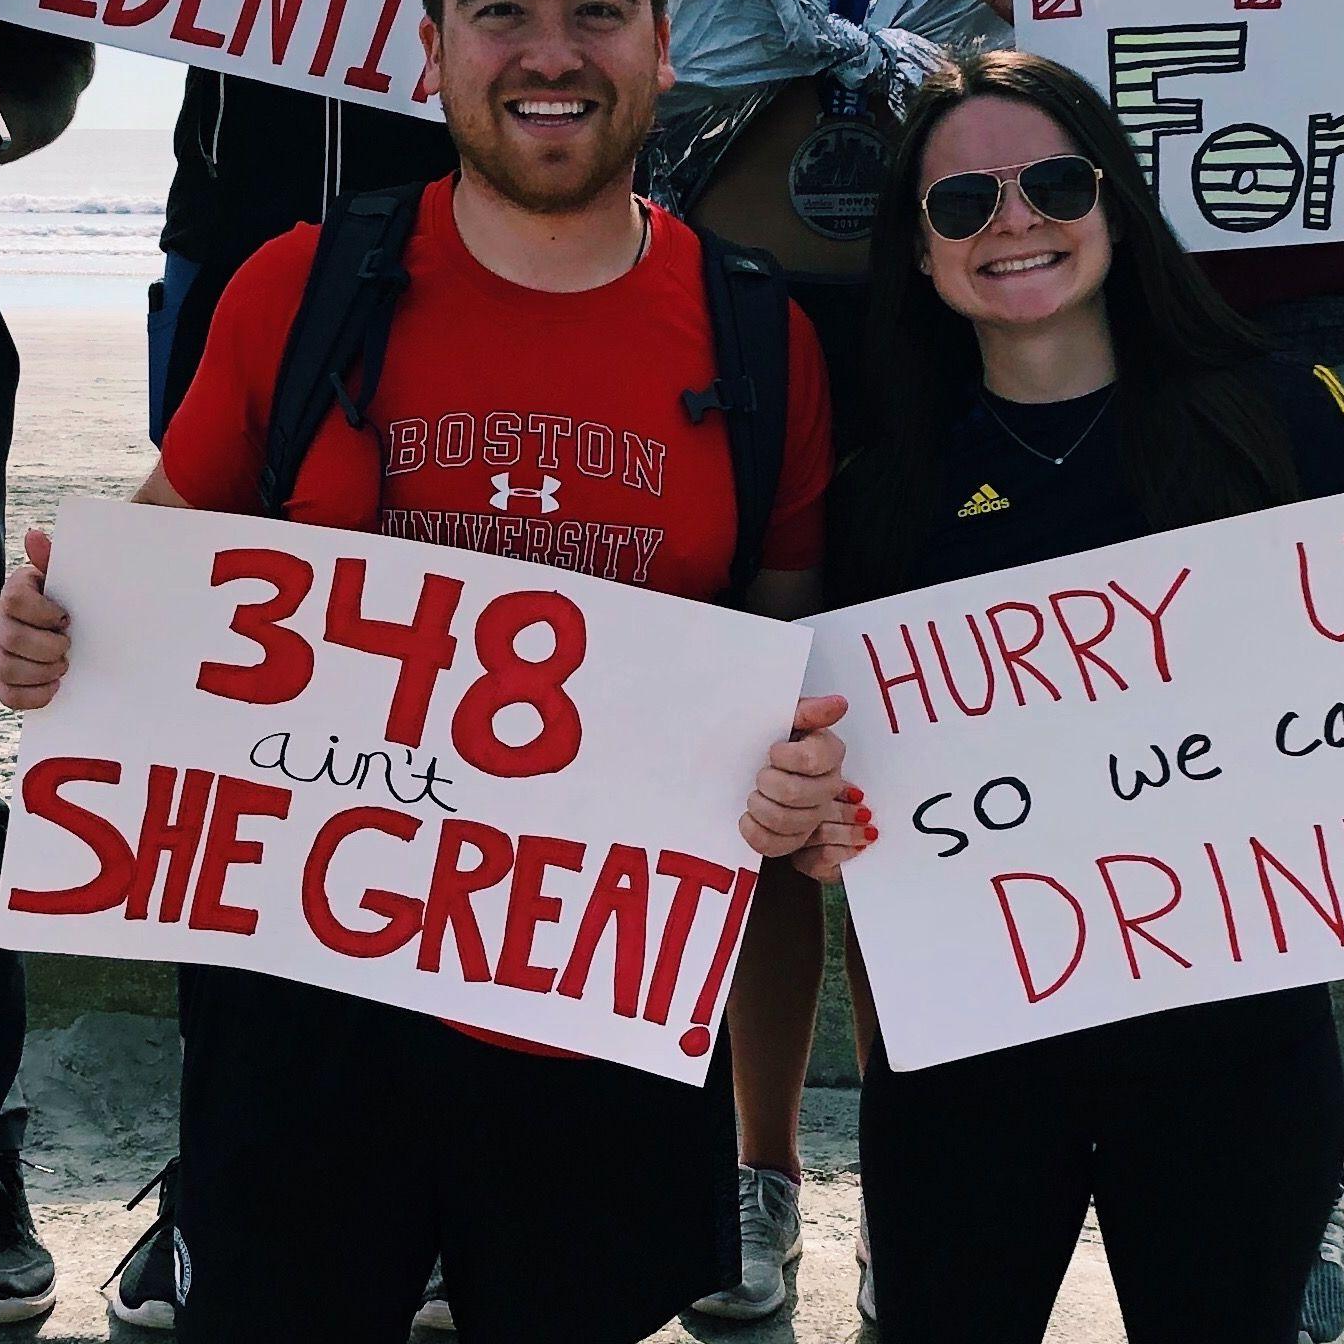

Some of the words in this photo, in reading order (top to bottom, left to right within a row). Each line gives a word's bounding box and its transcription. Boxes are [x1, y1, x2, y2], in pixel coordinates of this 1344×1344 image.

[385, 412, 666, 497] BOSTON
[957, 497, 1010, 517] adidas
[196, 548, 587, 778] 348
[861, 567, 1191, 735] HURRY
[250, 731, 458, 813] ain't
[1108, 731, 1223, 802] we
[8, 757, 292, 936] SHE
[301, 806, 760, 1058] GREAT!
